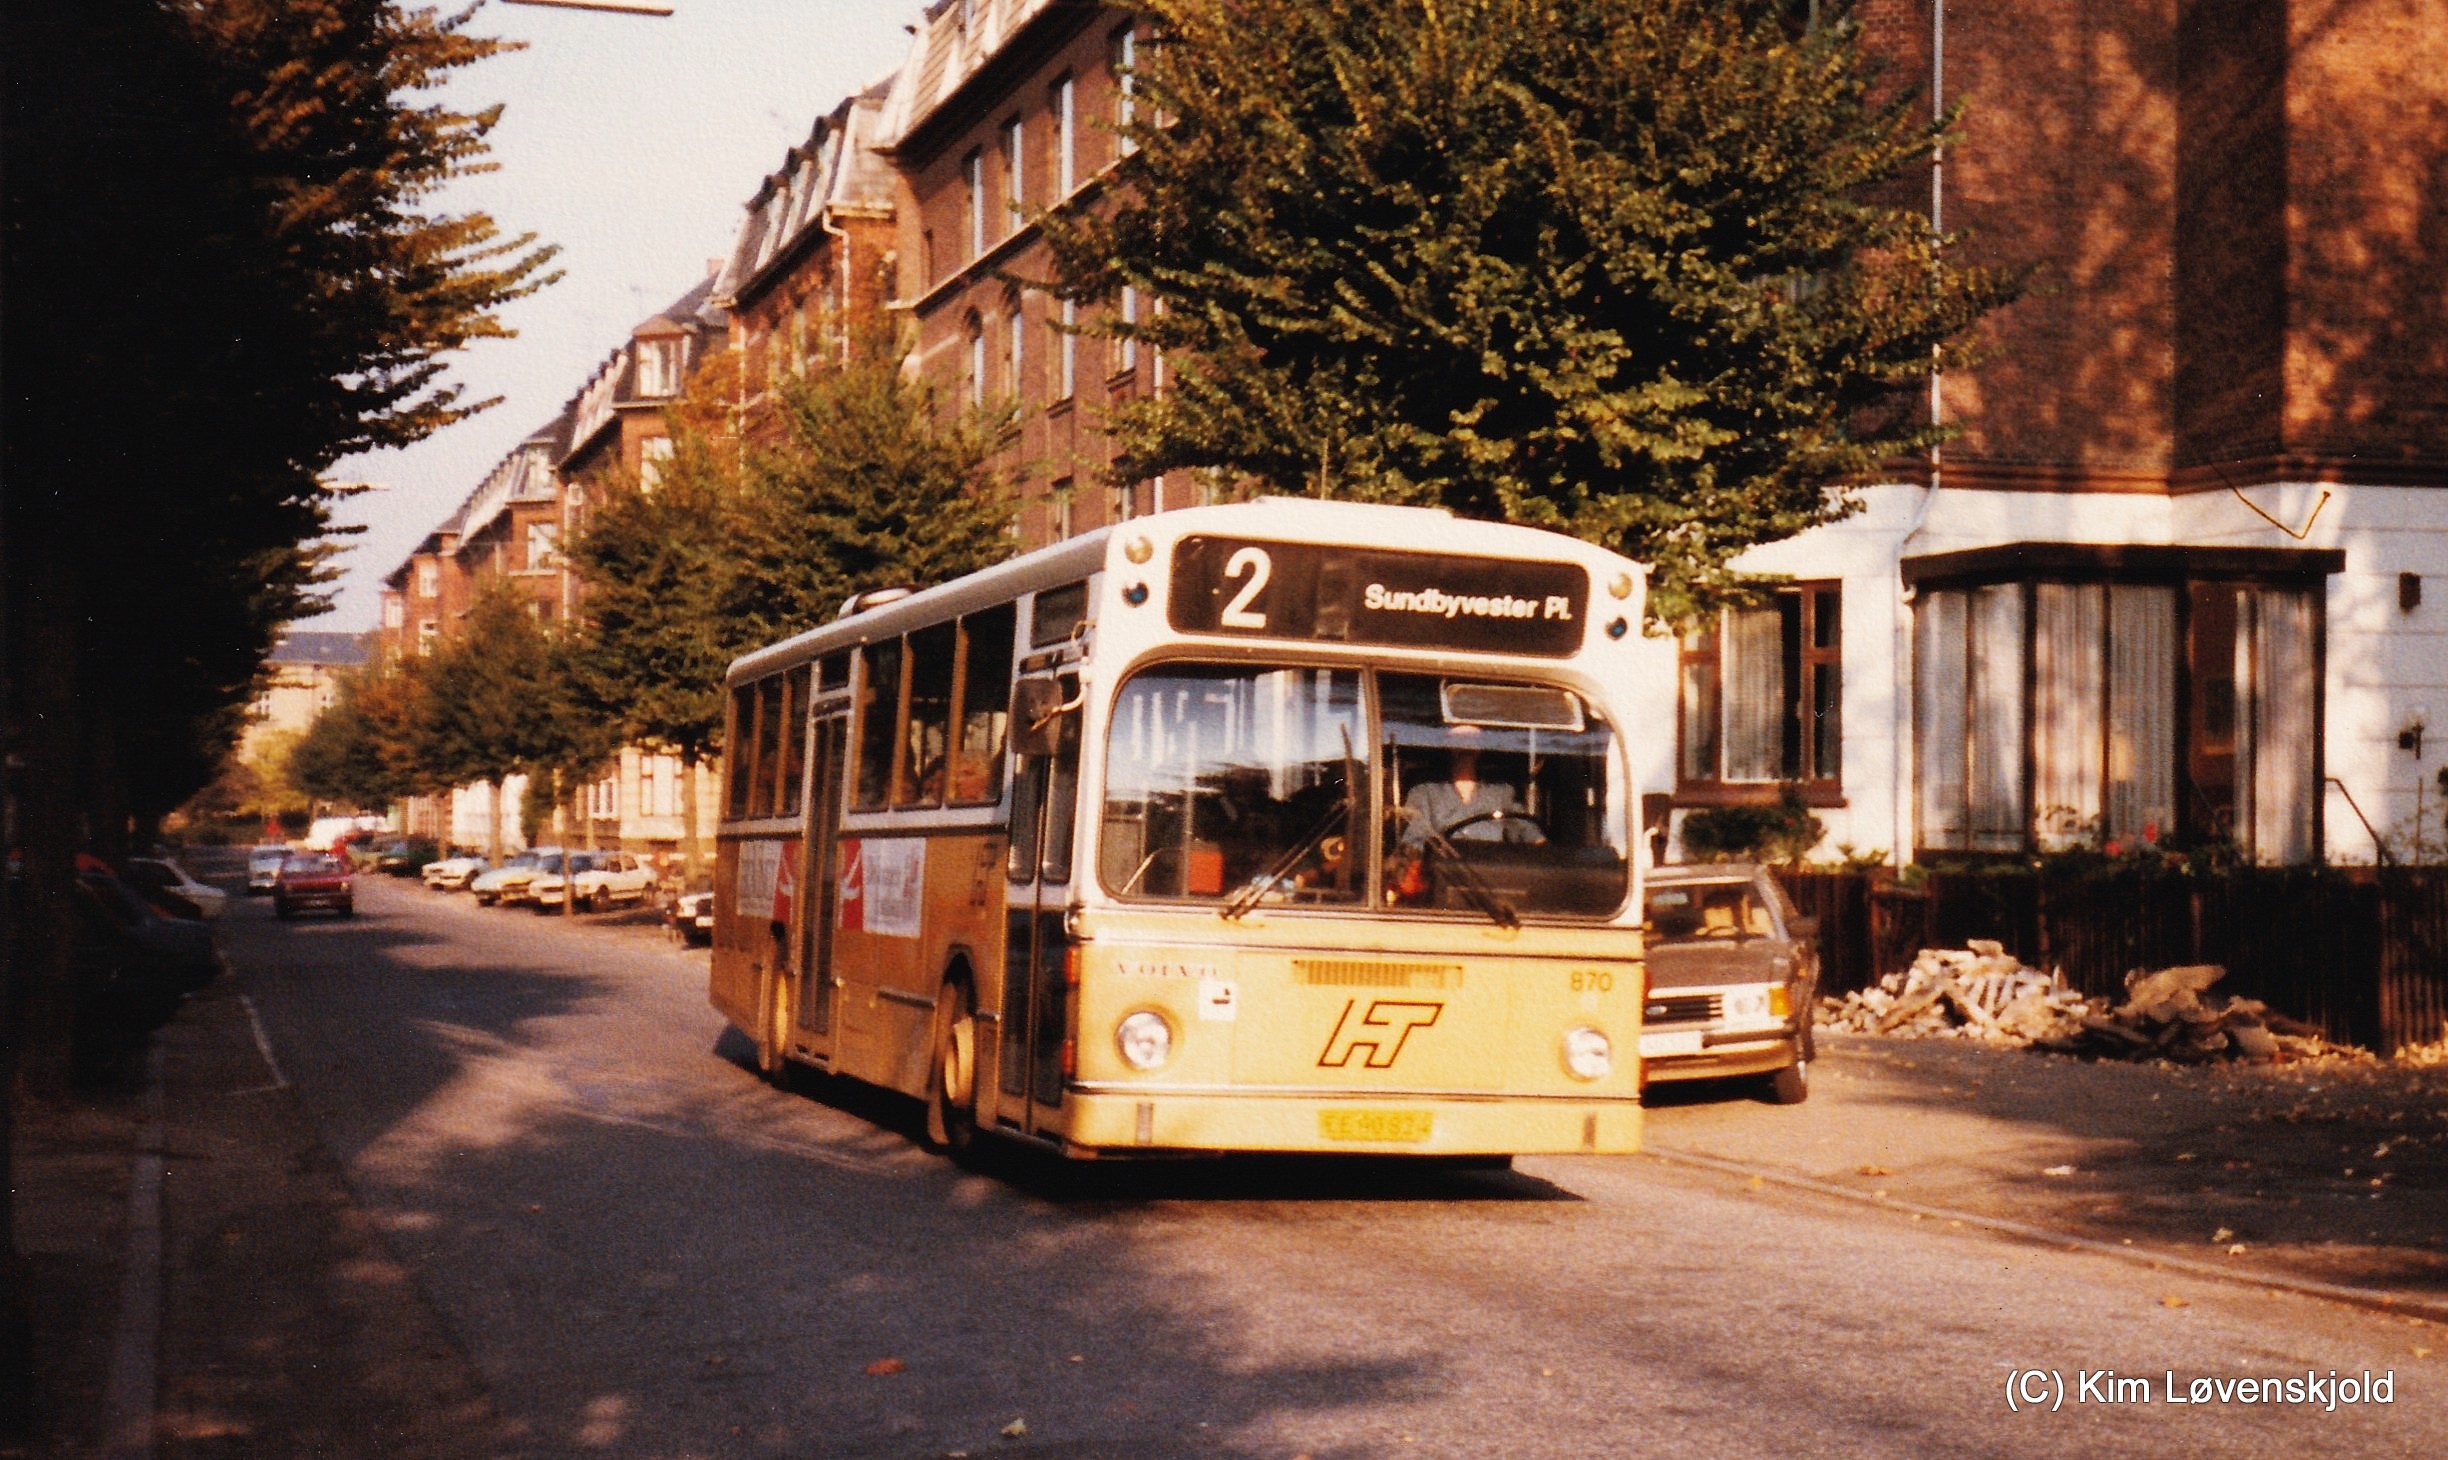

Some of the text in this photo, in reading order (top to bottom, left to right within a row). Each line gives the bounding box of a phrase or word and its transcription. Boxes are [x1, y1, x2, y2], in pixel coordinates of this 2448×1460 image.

[1221, 546, 1272, 629] 2
[1364, 583, 1539, 619] Sundbyvester
[1569, 970, 1614, 992] 870
[1316, 998, 1445, 1069] HT
